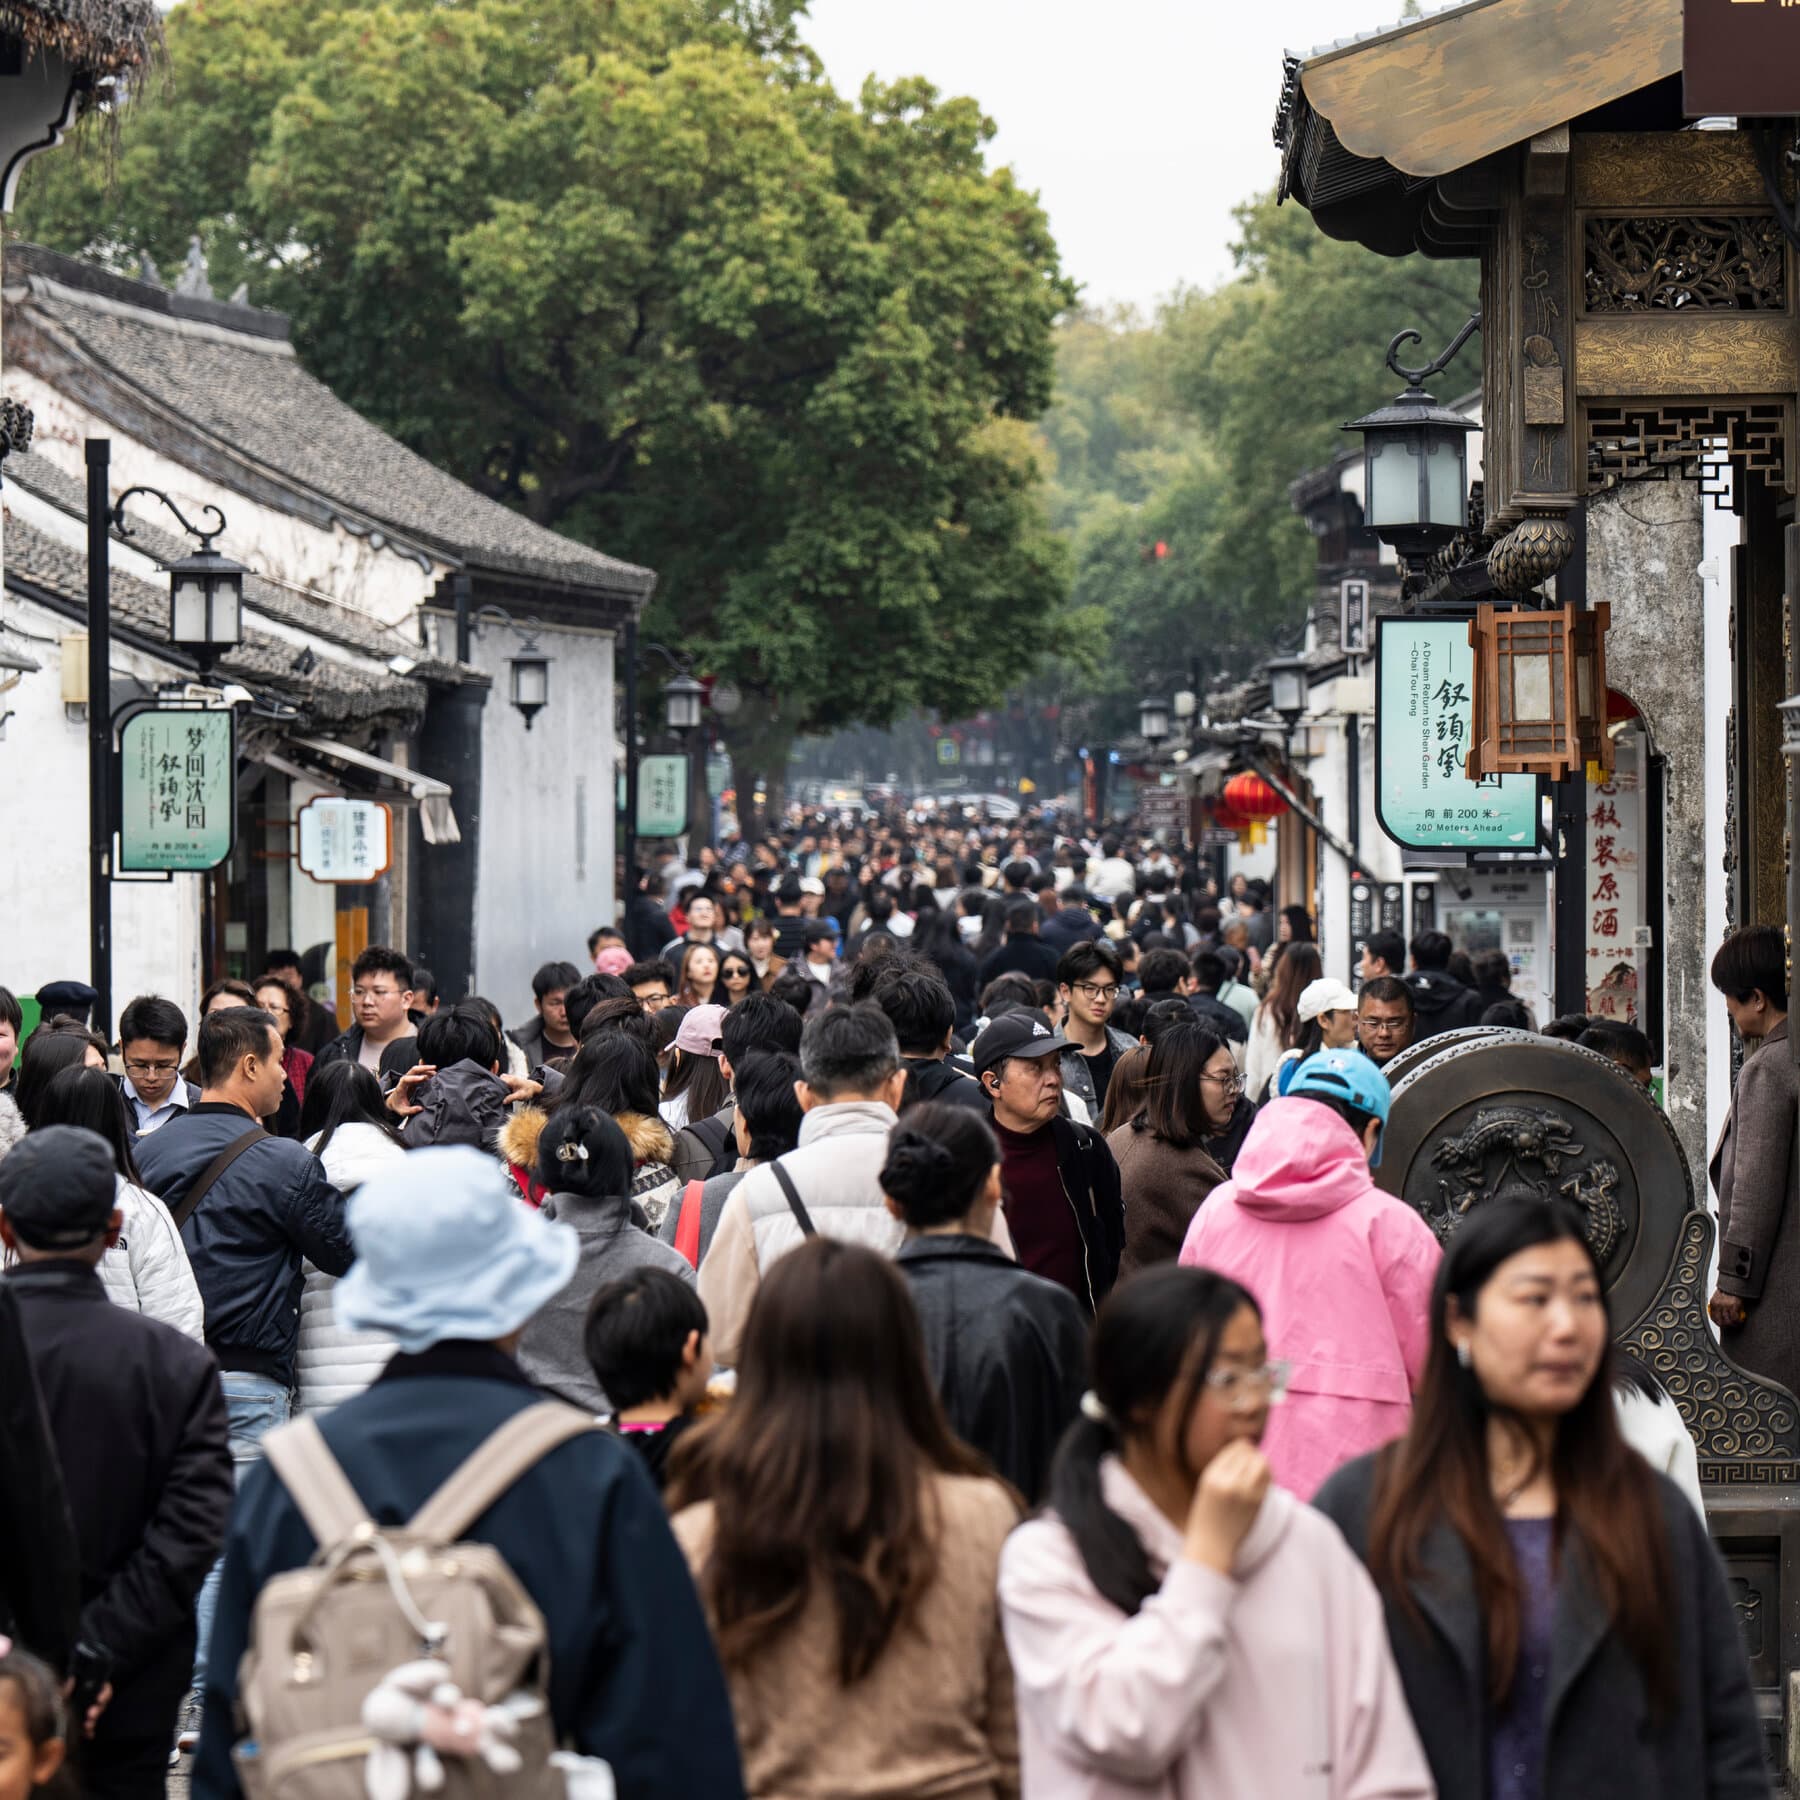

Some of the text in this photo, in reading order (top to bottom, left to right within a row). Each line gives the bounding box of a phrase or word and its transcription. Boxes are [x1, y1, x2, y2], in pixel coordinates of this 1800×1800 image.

[1423, 641, 1430, 649] A
[1410, 673, 1418, 691] Tou
[1409, 693, 1418, 717] Feng
[1423, 717, 1430, 727] to
[1422, 728, 1430, 753] Shen
[186, 727, 205, 829] 梦回沈园
[1421, 754, 1429, 789] Garden
